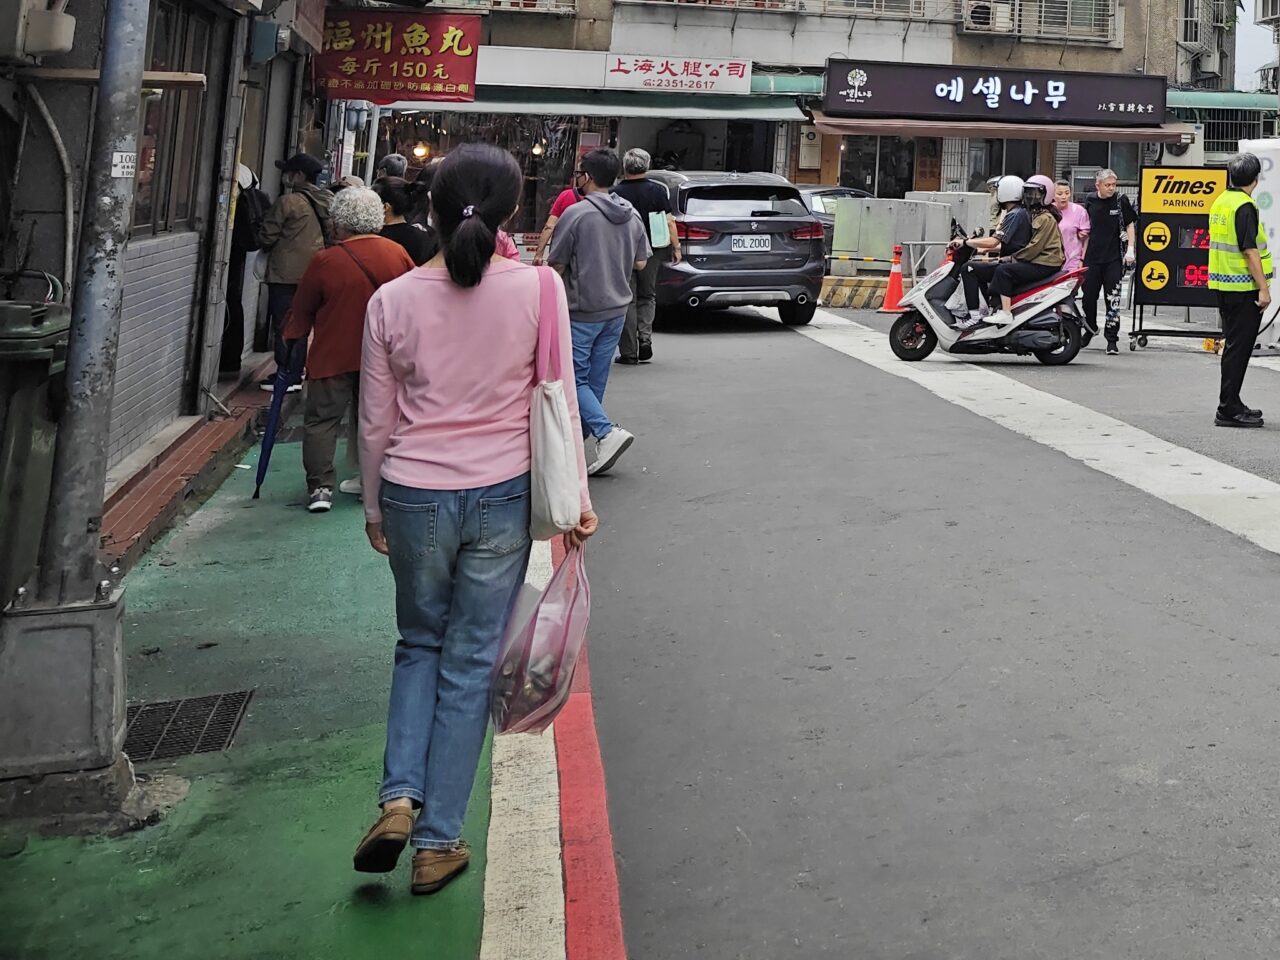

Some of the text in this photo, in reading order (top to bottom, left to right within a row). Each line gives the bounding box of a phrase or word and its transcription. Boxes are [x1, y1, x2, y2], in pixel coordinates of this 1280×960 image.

[324, 20, 473, 57] 福州魚丸
[610, 58, 746, 79] 上海火腿公司
[935, 76, 1067, 109] 에셀나무
[1152, 175, 1217, 195] Times
[1163, 199, 1204, 208] PARKING
